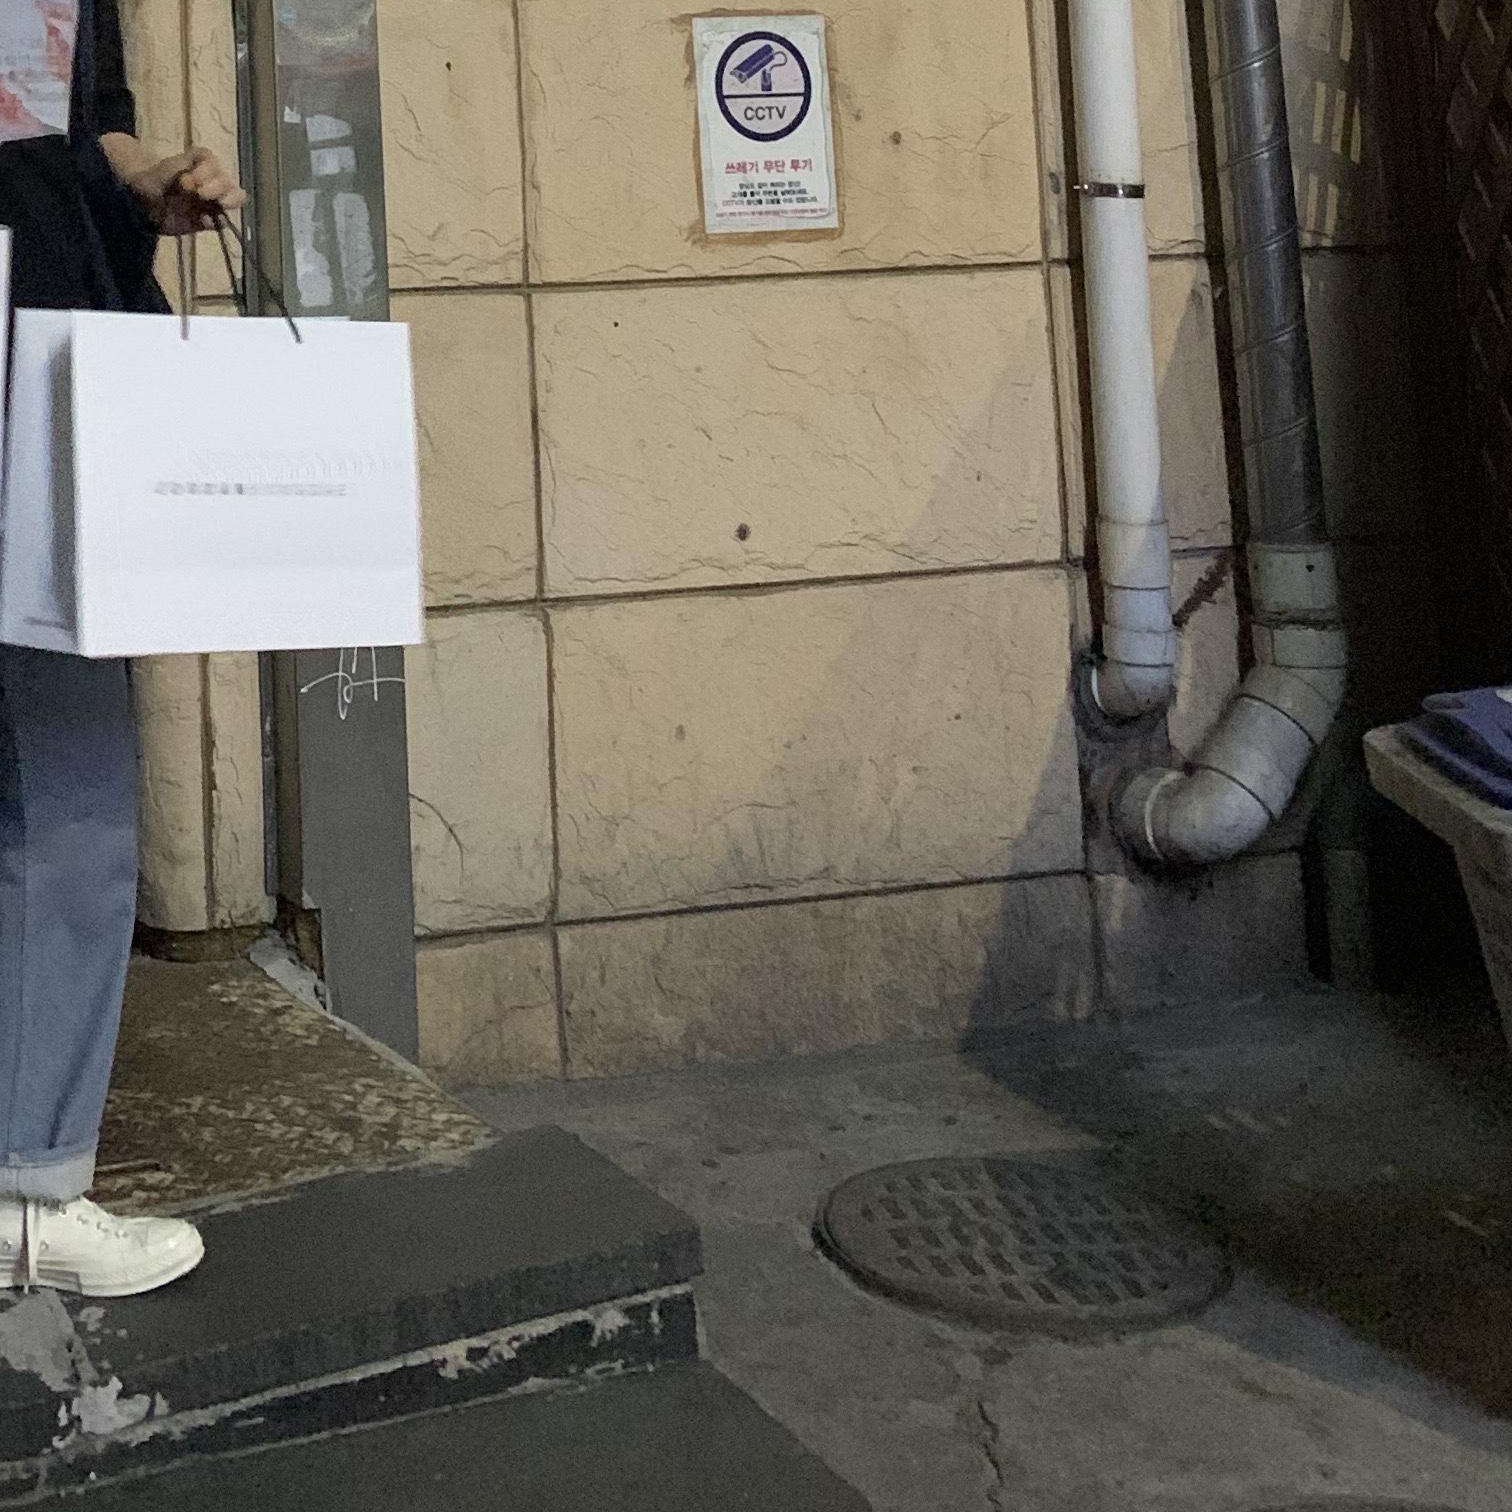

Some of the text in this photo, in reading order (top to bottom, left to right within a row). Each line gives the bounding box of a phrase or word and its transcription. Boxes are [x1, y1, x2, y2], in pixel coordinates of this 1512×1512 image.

[744, 106, 786, 121] CCTV
[725, 158, 813, 174] 쓰레기 무단 투기
